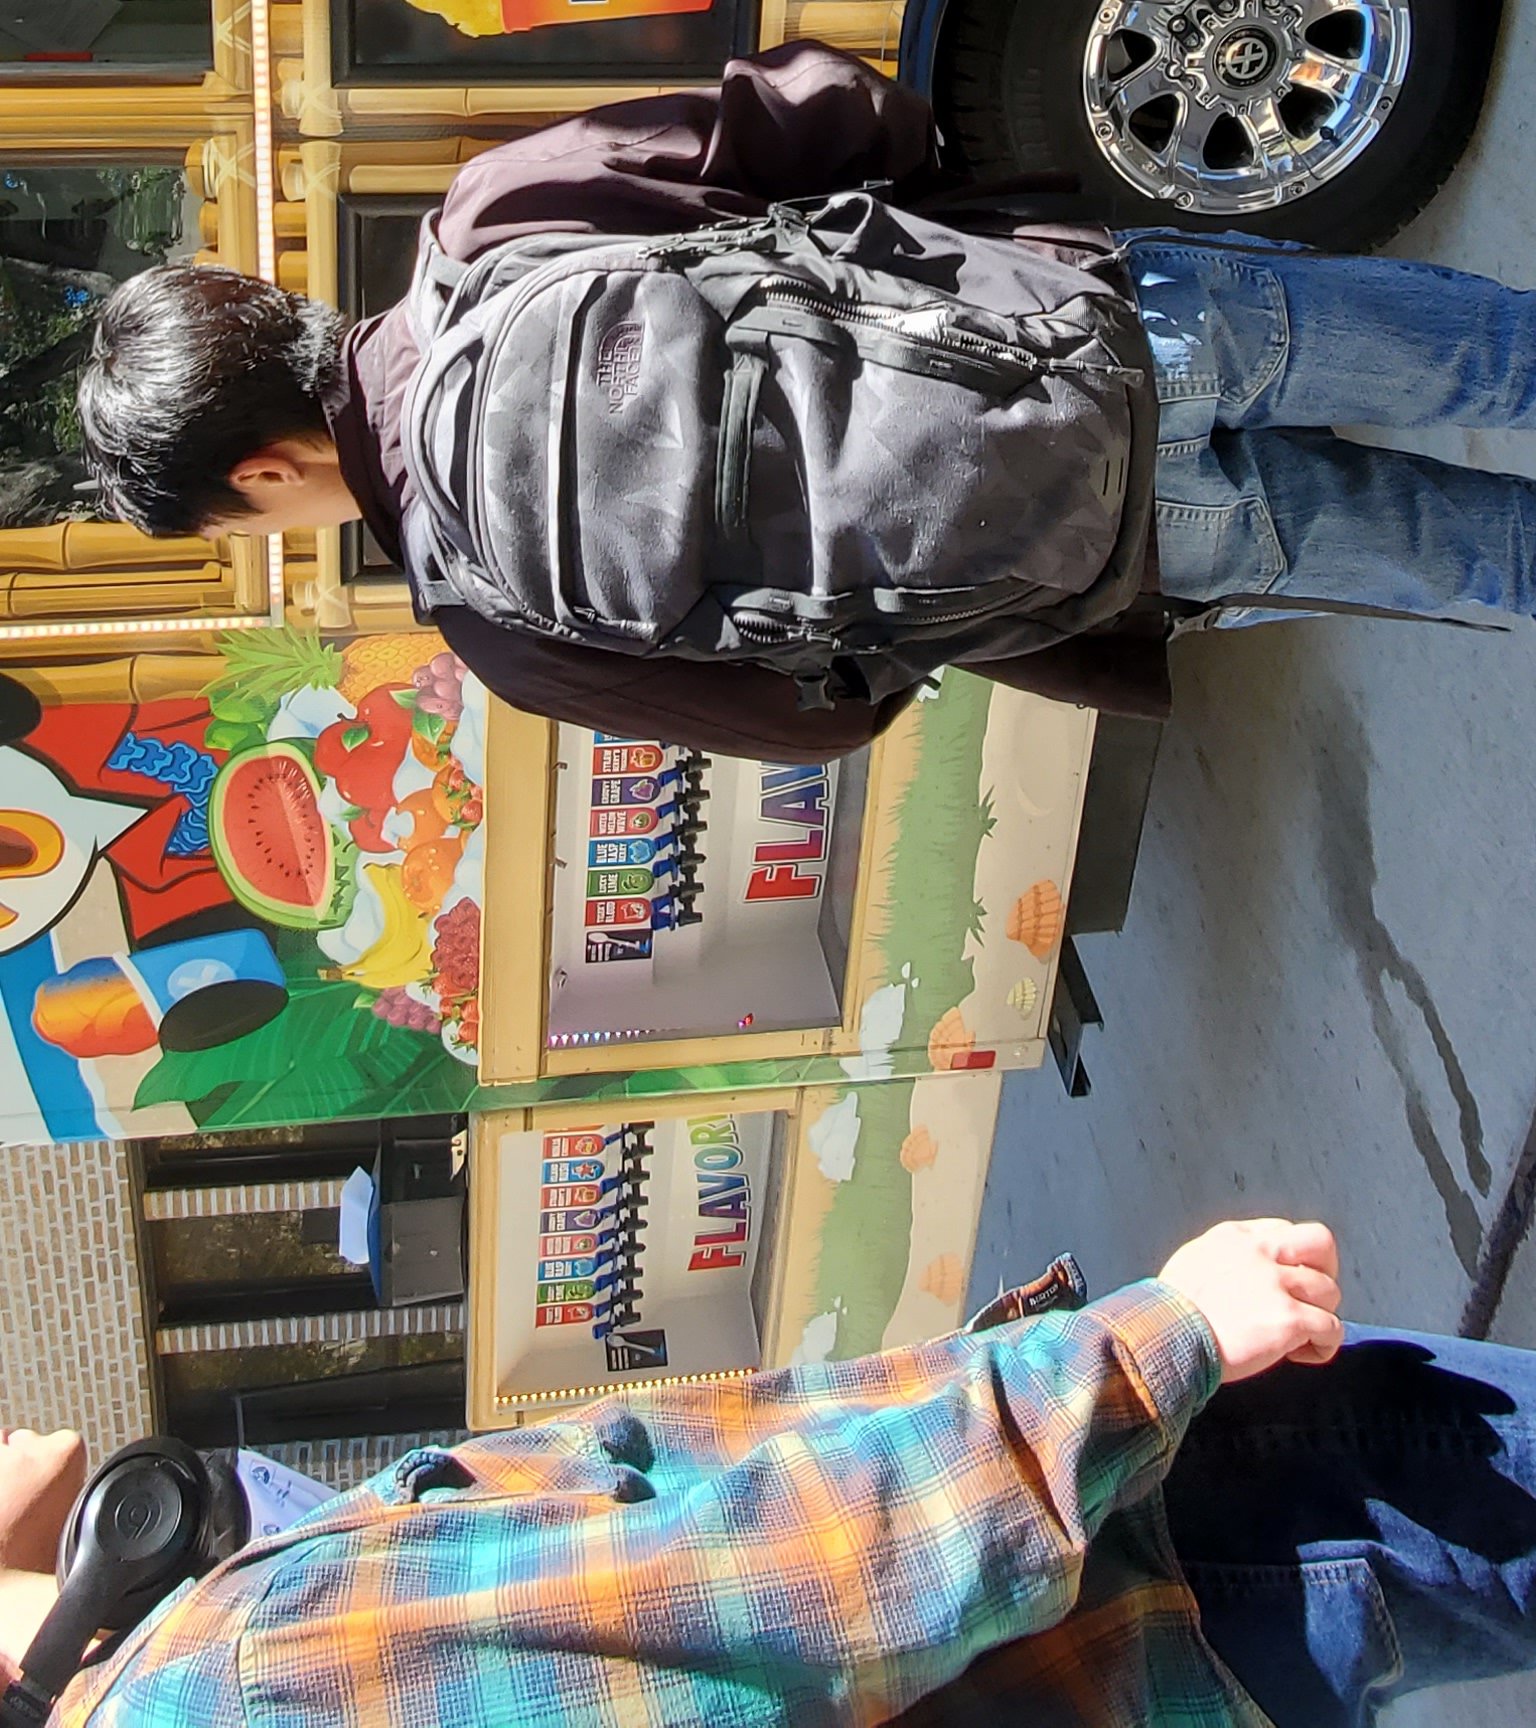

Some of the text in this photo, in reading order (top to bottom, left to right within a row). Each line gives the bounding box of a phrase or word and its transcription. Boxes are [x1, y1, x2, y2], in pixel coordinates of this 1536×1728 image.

[596, 350, 613, 386] THE
[624, 350, 640, 395] FACE
[609, 352, 629, 413] NORTH
[602, 749, 612, 772] STRAW
[610, 779, 621, 803] GRAPE
[607, 811, 617, 834] MELON
[616, 811, 626, 833] WAVE
[596, 843, 607, 863] BLUE
[607, 843, 618, 862] RASP
[618, 843, 627, 862] BERRY
[607, 873, 618, 893] LIME
